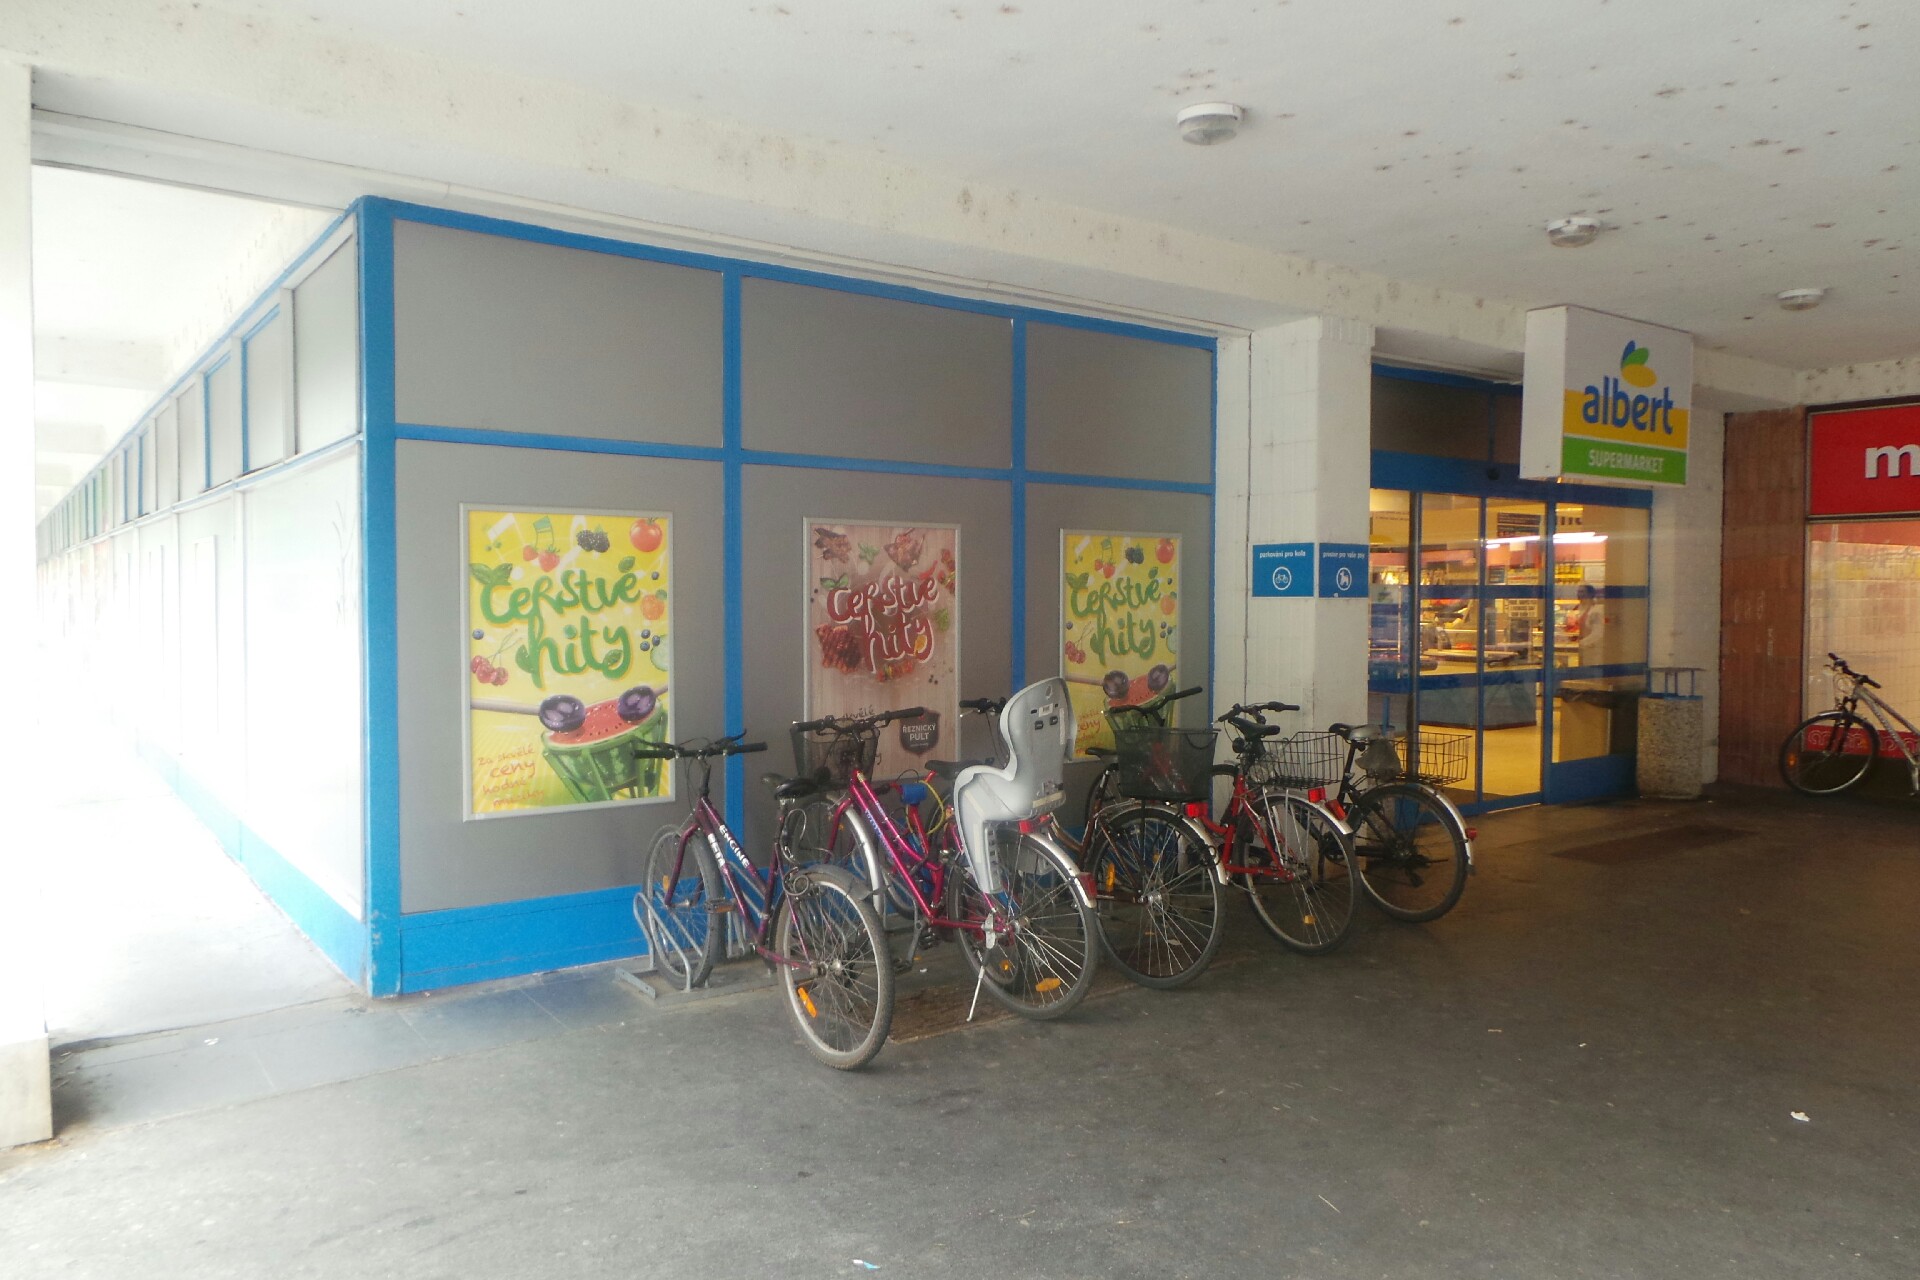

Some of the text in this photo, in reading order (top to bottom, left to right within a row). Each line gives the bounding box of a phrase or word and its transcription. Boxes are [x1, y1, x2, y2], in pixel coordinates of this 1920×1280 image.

[1583, 375, 1674, 435] albert
[1588, 449, 1664, 473] SUPERMARKET
[524, 615, 633, 690] hity
[864, 615, 935, 675] hity
[1095, 611, 1157, 667] hity
[909, 732, 930, 741] PULT
[490, 761, 536, 779] ceny
[719, 824, 750, 868] ENGINE
